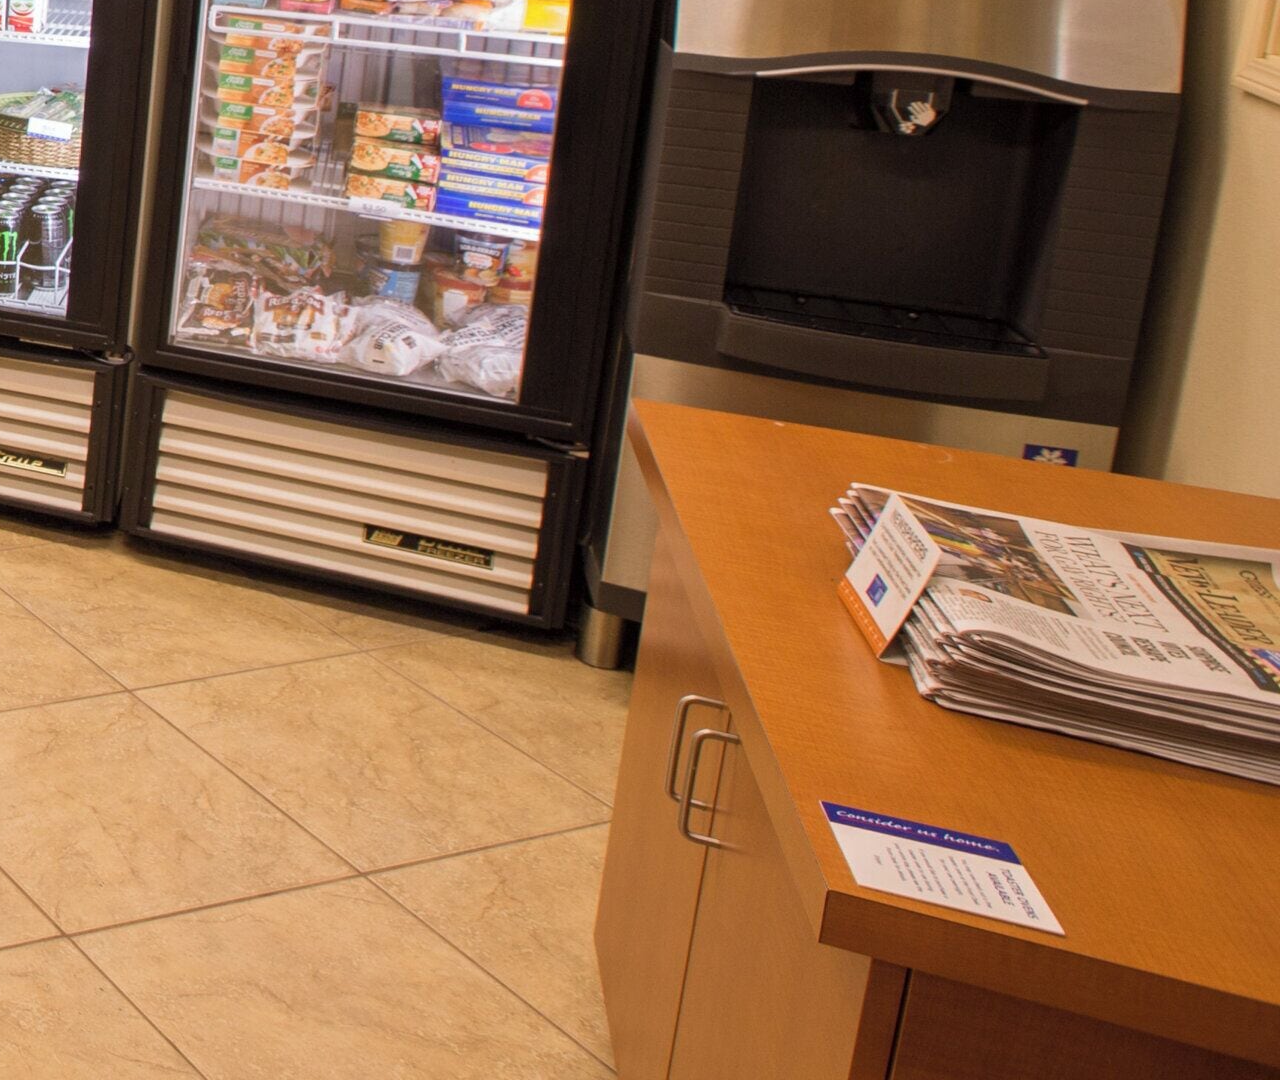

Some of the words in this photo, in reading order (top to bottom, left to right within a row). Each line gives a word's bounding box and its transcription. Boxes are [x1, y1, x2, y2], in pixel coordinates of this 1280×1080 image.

[835, 809, 913, 833] Consider
[916, 828, 939, 839] us
[942, 832, 1001, 854] home.
